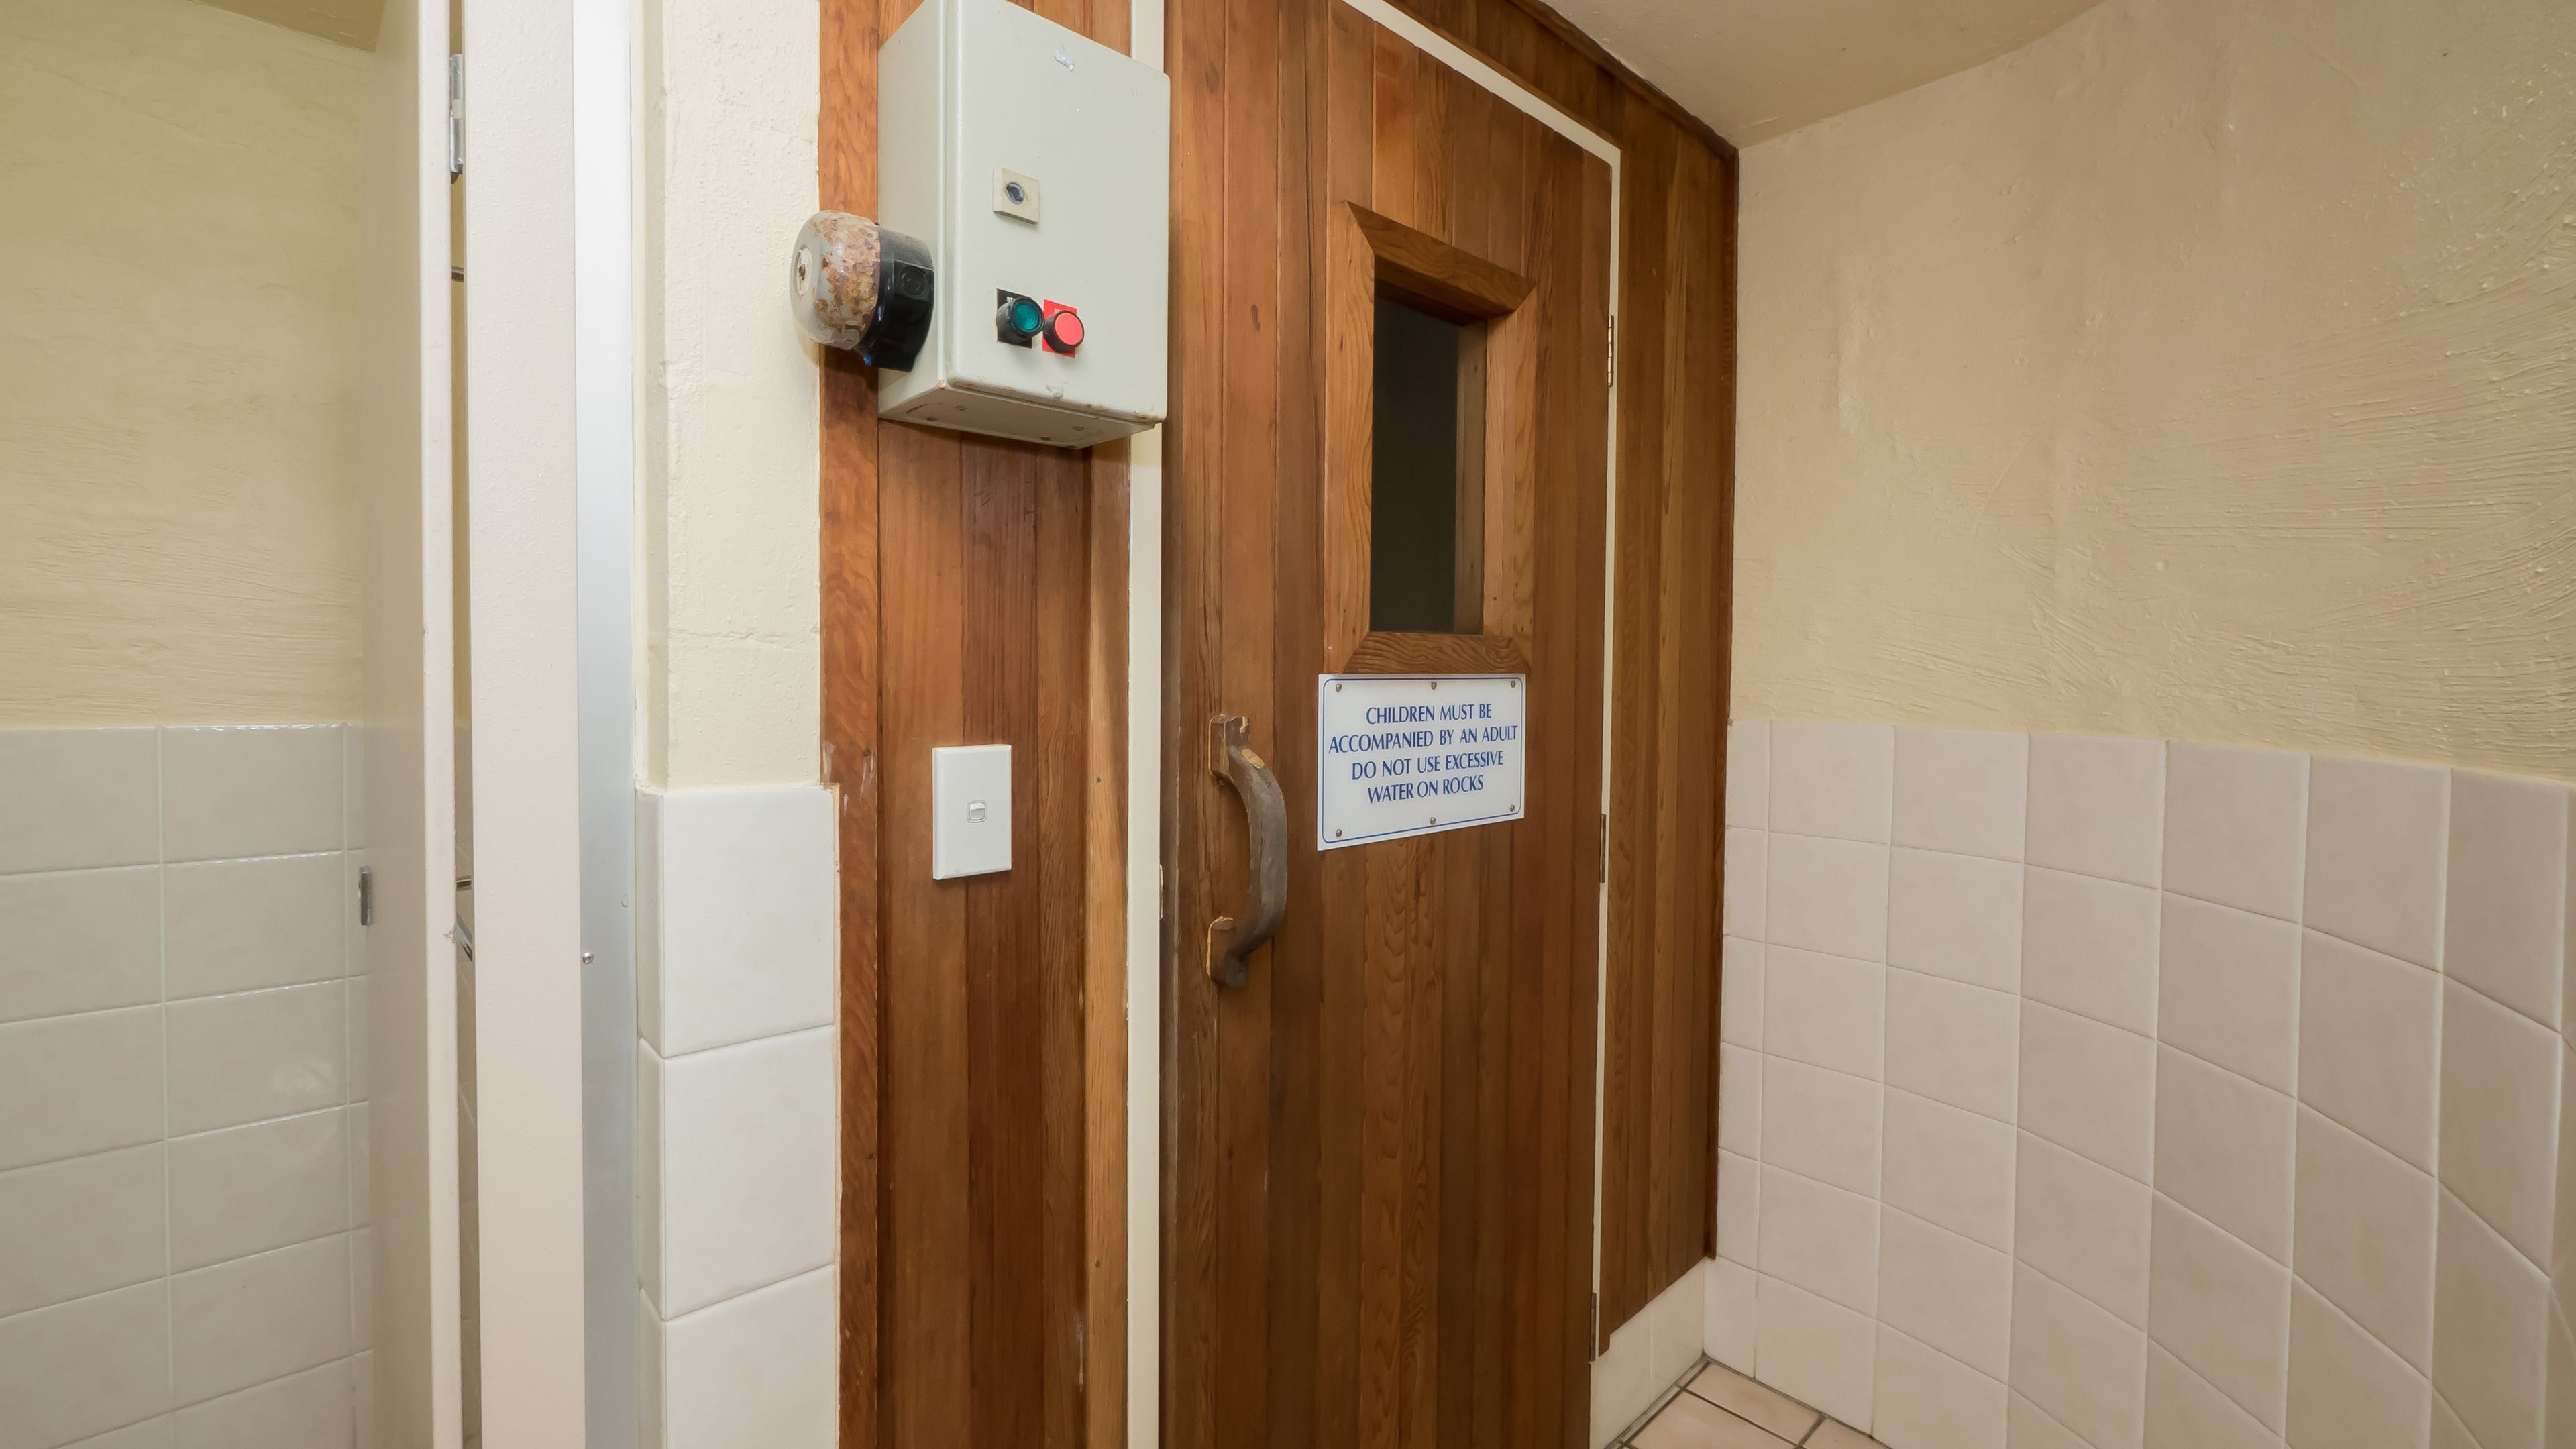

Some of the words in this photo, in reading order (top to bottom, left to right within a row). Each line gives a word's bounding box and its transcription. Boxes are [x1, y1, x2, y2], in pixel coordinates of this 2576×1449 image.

[1366, 706, 1435, 724] CHILDREN
[1440, 704, 1474, 720] MUST
[1479, 703, 1492, 719] BE
[1329, 731, 1434, 753] ACCOMPANIED
[1439, 729, 1454, 745] BY
[1459, 729, 1478, 743] AN
[1481, 725, 1518, 741] ADULT
[1352, 761, 1377, 780] DO
[1381, 758, 1411, 776] NOT
[1417, 755, 1441, 773] USE
[1445, 750, 1504, 771] EXCESSIVE
[1367, 782, 1414, 804] WATER
[1417, 780, 1438, 798] ON
[1442, 775, 1484, 794] ROCKS
